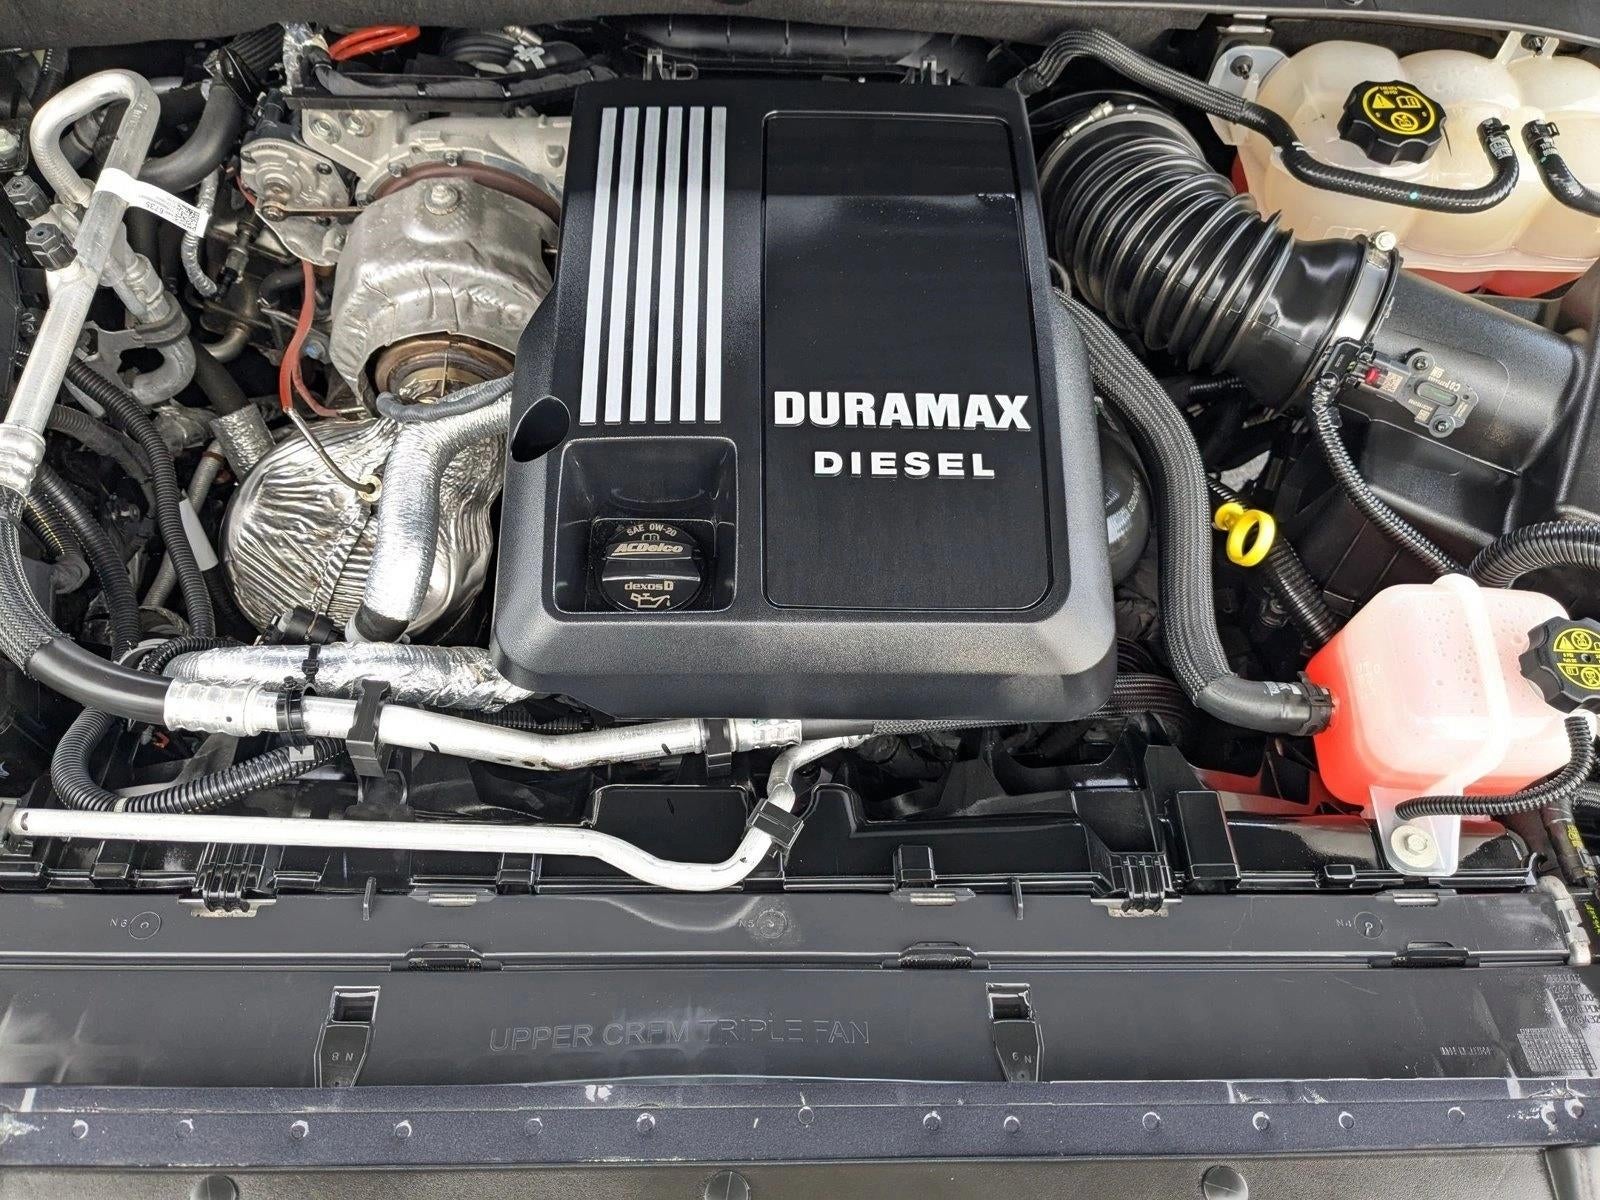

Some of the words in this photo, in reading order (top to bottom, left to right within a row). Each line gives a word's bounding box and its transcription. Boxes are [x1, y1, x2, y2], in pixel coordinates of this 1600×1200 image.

[774, 391, 1031, 430] DURAMAX
[814, 451, 995, 478] DIESEL
[626, 523, 645, 536] SAE
[649, 523, 677, 537] 0W-20
[613, 542, 684, 553] ACDelco
[489, 1023, 594, 1051] UPPER
[602, 1019, 689, 1047] CRFM
[698, 1018, 804, 1043] TRIPLE
[812, 1019, 870, 1044] FAN
